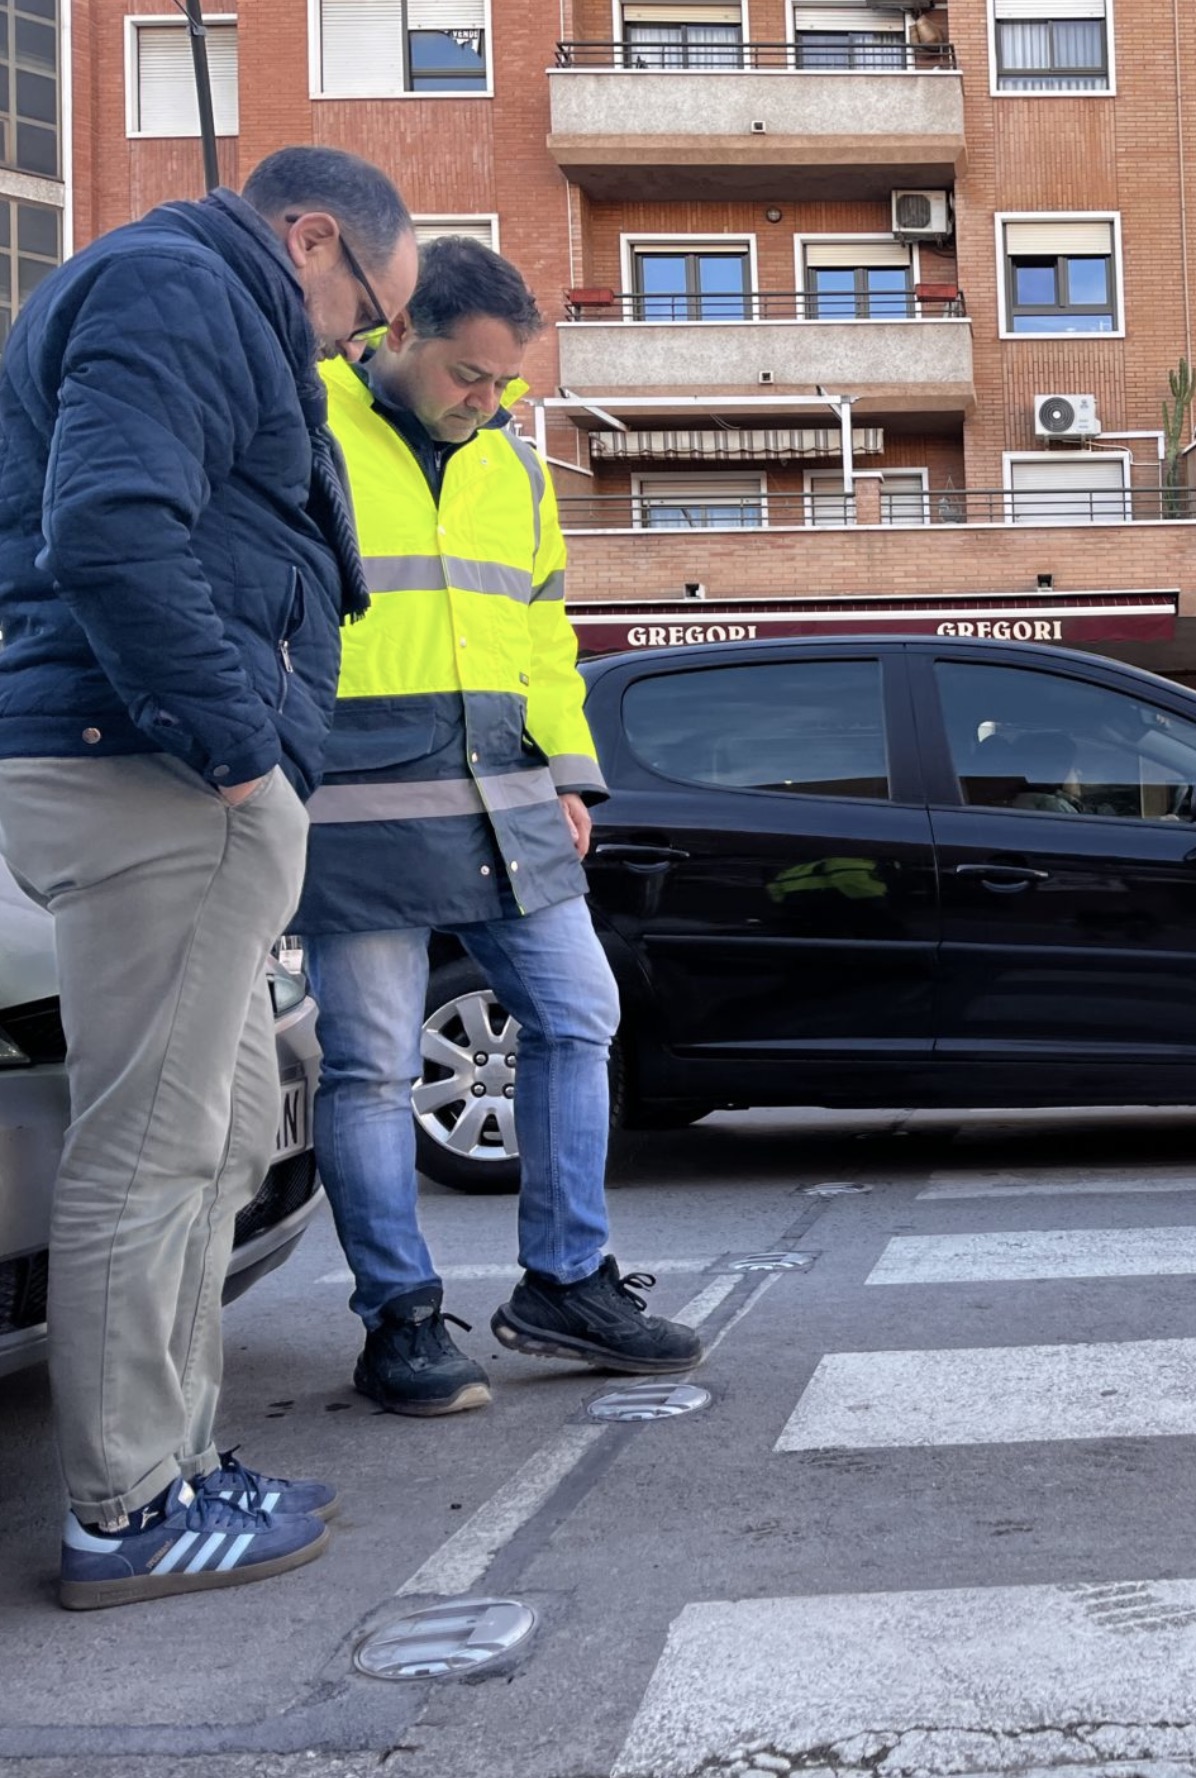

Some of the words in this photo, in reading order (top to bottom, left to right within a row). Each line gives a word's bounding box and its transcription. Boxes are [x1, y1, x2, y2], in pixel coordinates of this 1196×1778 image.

[627, 625, 757, 646] GREGORI
[936, 620, 1063, 640] GREGORI
[276, 1090, 299, 1151] N
